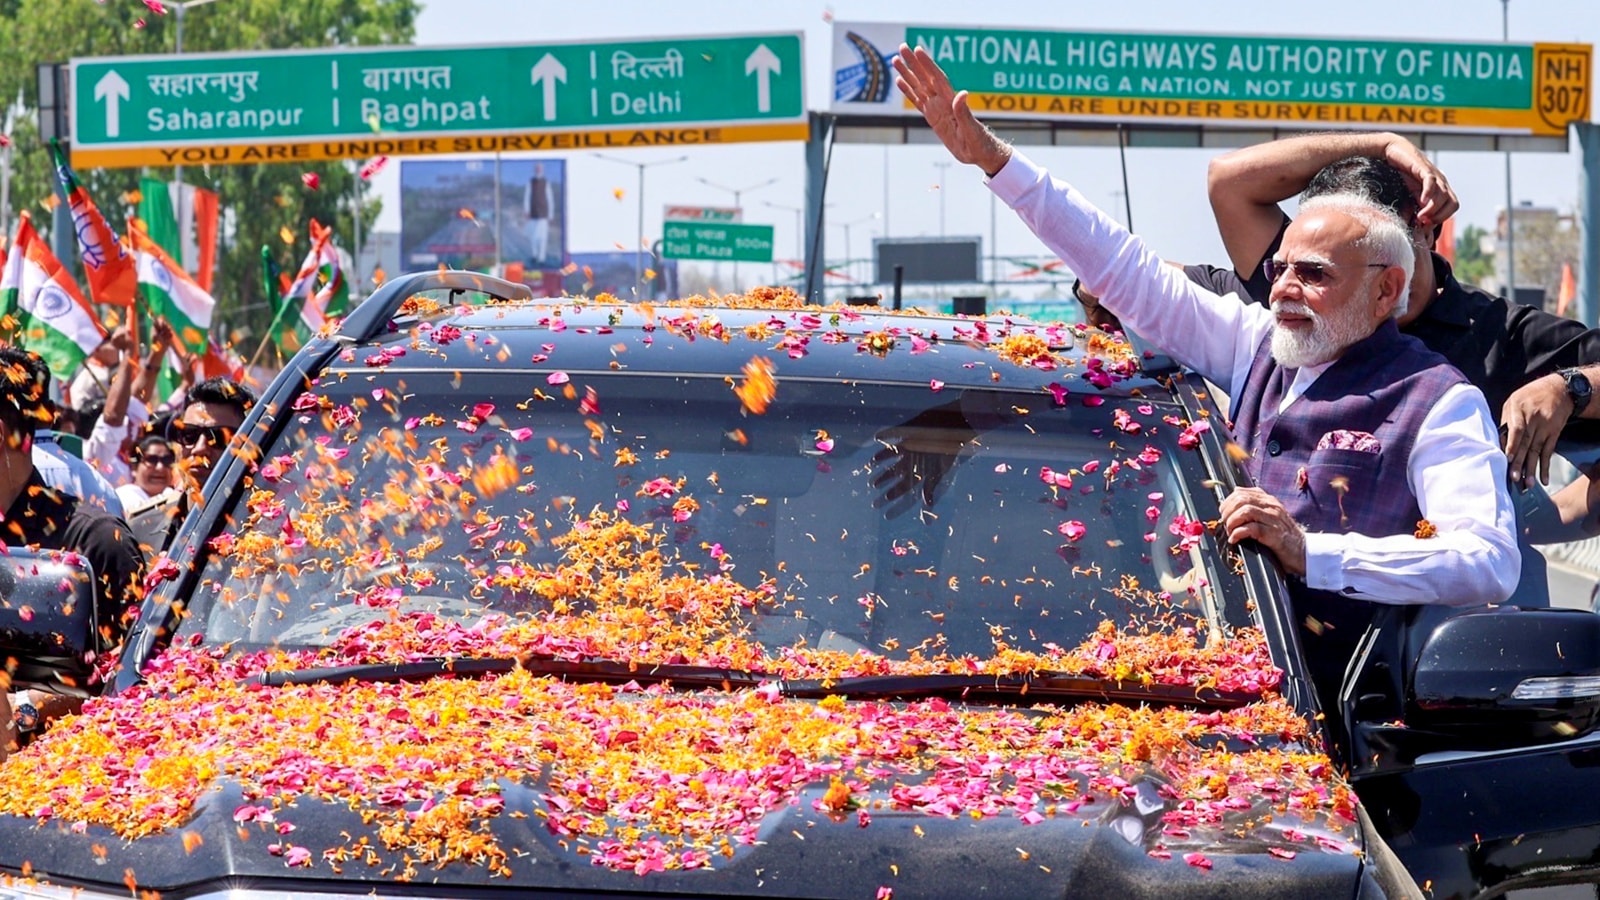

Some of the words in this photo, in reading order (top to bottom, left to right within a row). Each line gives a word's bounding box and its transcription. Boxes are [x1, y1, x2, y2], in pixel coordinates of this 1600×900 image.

[611, 48, 684, 80] दिल्ली
[917, 35, 1057, 67] NATIONAL
[1067, 39, 1217, 71] HIGHWAYS
[1227, 44, 1388, 76] AUTHORITY
[1395, 48, 1433, 78] OF
[1442, 51, 1524, 80] INDIA
[1546, 58, 1582, 81] NH
[147, 71, 259, 102] सहारनपुर
[361, 66, 451, 92] बागपत
[993, 71, 1109, 92] BUILDING
[1119, 76, 1133, 93] A
[1245, 79, 1293, 96] NOT
[1300, 81, 1356, 99] JUST
[1365, 83, 1446, 102] ROADS
[361, 95, 491, 128] Baghpat
[611, 91, 682, 116] Delhi
[981, 95, 1038, 111] YOU
[1049, 97, 1104, 115] ARE
[1118, 101, 1222, 117] UNDER
[1233, 103, 1458, 125] SURVEILLANCE
[1543, 86, 1583, 115] 307
[147, 106, 303, 131] Saharanpur
[160, 147, 231, 163] YOU
[239, 143, 311, 161] ARE
[323, 138, 438, 156] UNDER
[452, 129, 722, 152] SURVEILLANCE
[666, 241, 691, 255] Toll
[696, 243, 733, 257] Plaza
